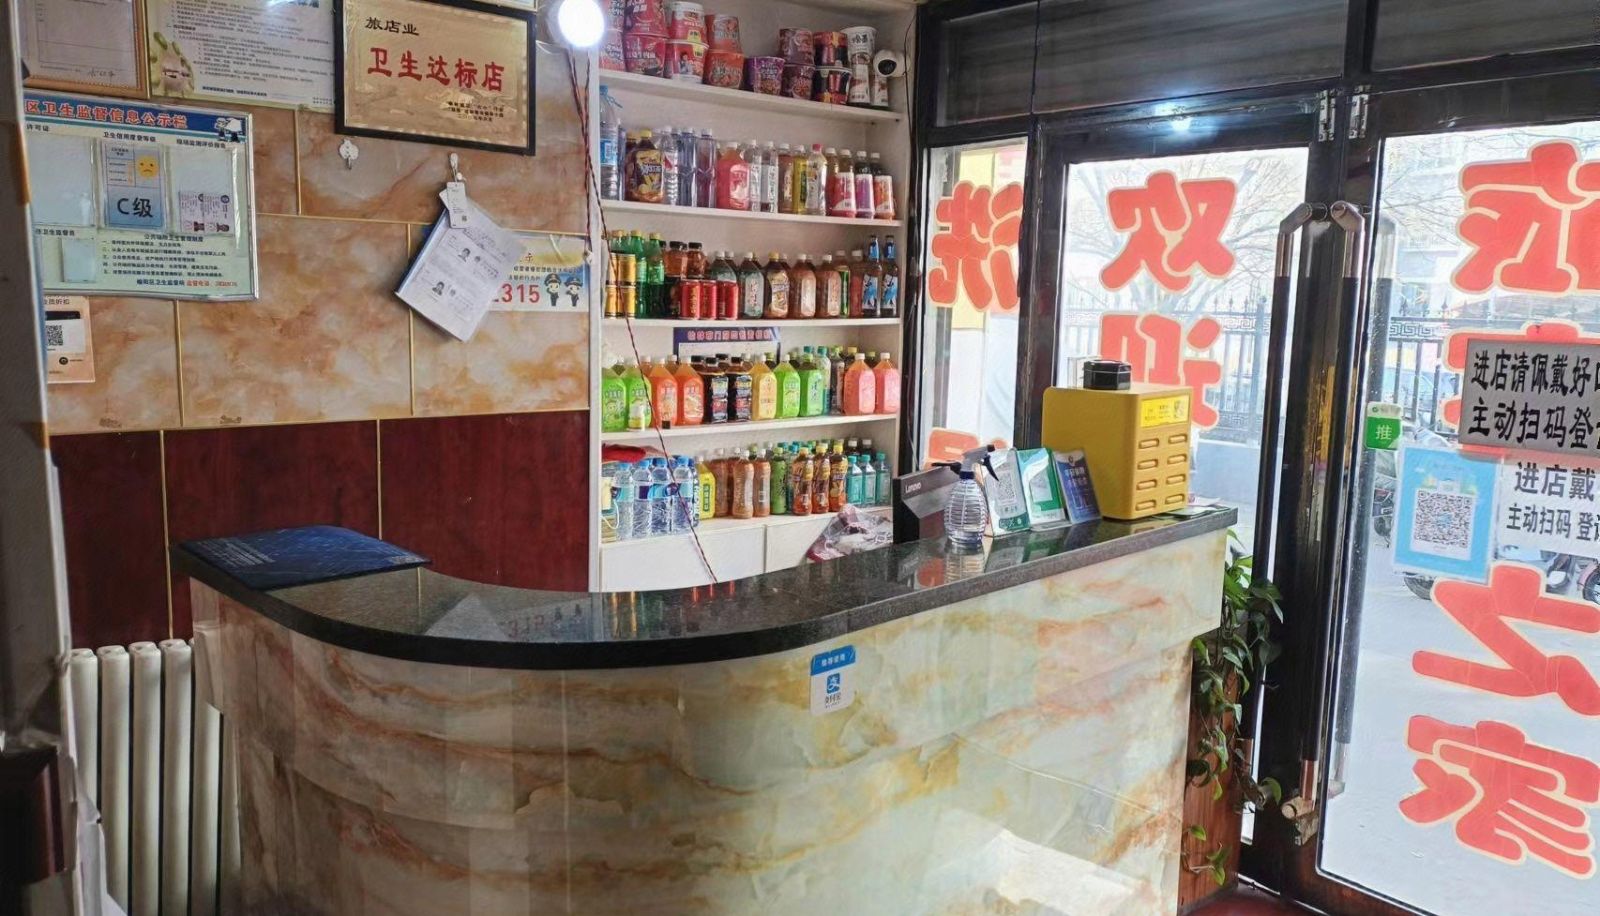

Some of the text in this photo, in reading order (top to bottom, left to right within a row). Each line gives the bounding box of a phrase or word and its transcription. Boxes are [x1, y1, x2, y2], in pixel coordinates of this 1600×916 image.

[366, 17, 420, 36] 旅店业
[367, 47, 505, 92] 卫生达标店
[25, 100, 188, 129] 区卫生监督信息公示栏
[117, 197, 154, 218] C级
[494, 283, 541, 303] 315
[1375, 424, 1393, 441] 推
[906, 482, 922, 493] Lenovo
[1514, 461, 1596, 502] 进店戴
[1506, 502, 1571, 539] 主动扫码
